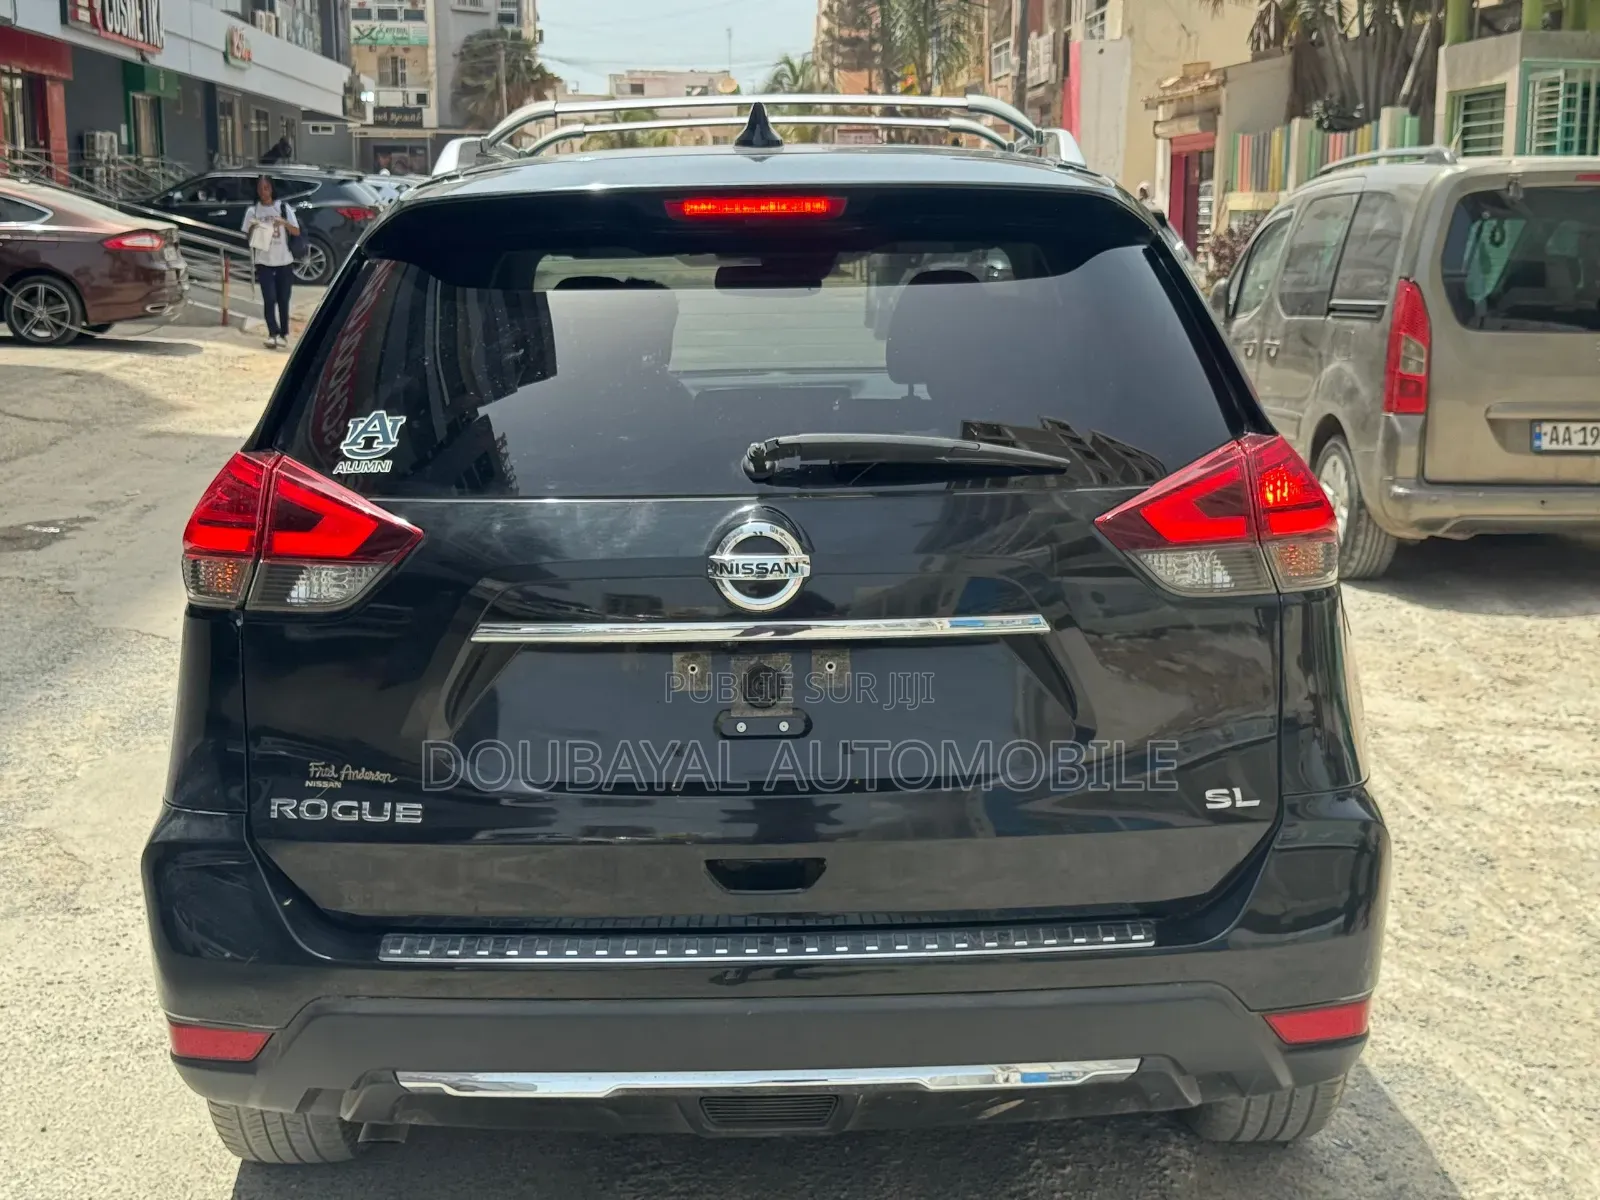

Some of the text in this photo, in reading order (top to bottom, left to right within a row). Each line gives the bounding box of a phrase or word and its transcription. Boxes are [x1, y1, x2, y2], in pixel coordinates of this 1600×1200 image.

[332, 460, 393, 474] ALUMNI
[719, 561, 800, 576] NISSAN
[309, 761, 398, 783] Fred Anderson
[305, 780, 342, 788] NISSAN
[1204, 787, 1261, 810] SL
[269, 797, 423, 823] ROGUE
